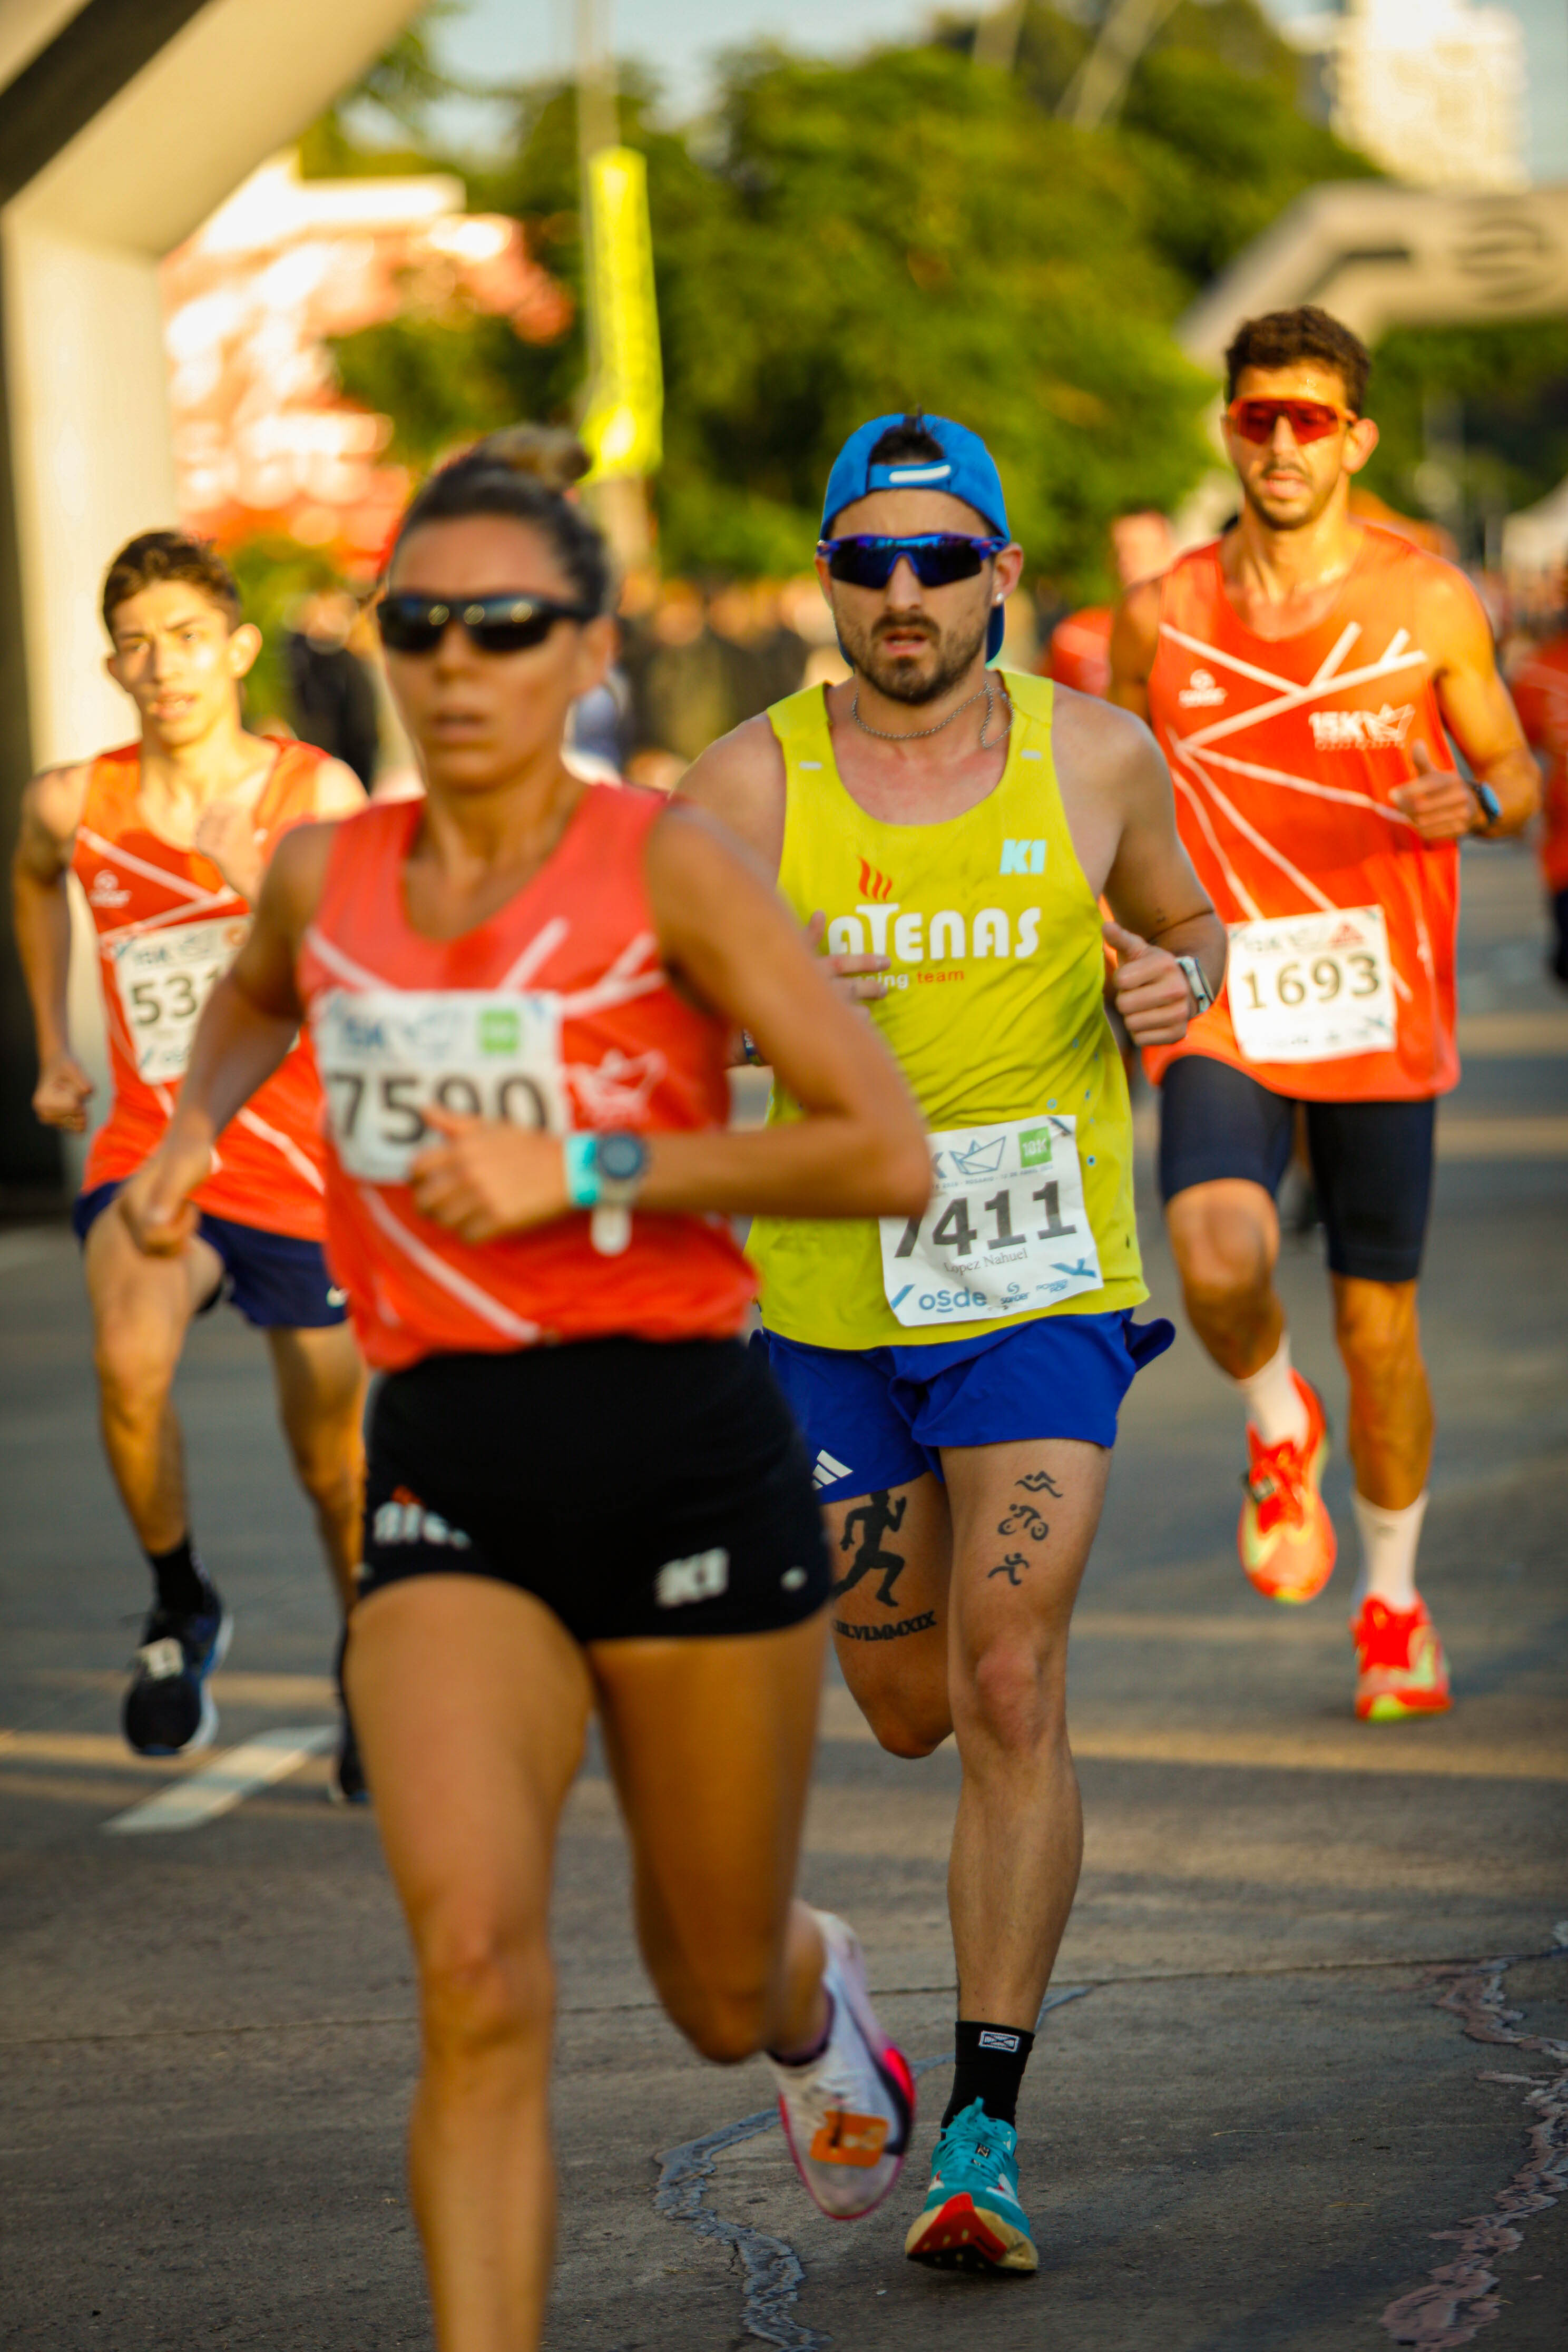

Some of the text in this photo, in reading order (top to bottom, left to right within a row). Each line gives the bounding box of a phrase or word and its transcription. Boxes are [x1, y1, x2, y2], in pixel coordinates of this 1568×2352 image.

[999, 839, 1047, 875] K1
[917, 969, 964, 984] team
[1241, 953, 1380, 1009] 1693
[131, 966, 220, 1026] 53
[1022, 1138, 1048, 1157] 10K
[944, 1248, 1028, 1276] Lopez Nahuel
[919, 1287, 987, 1311] osde
